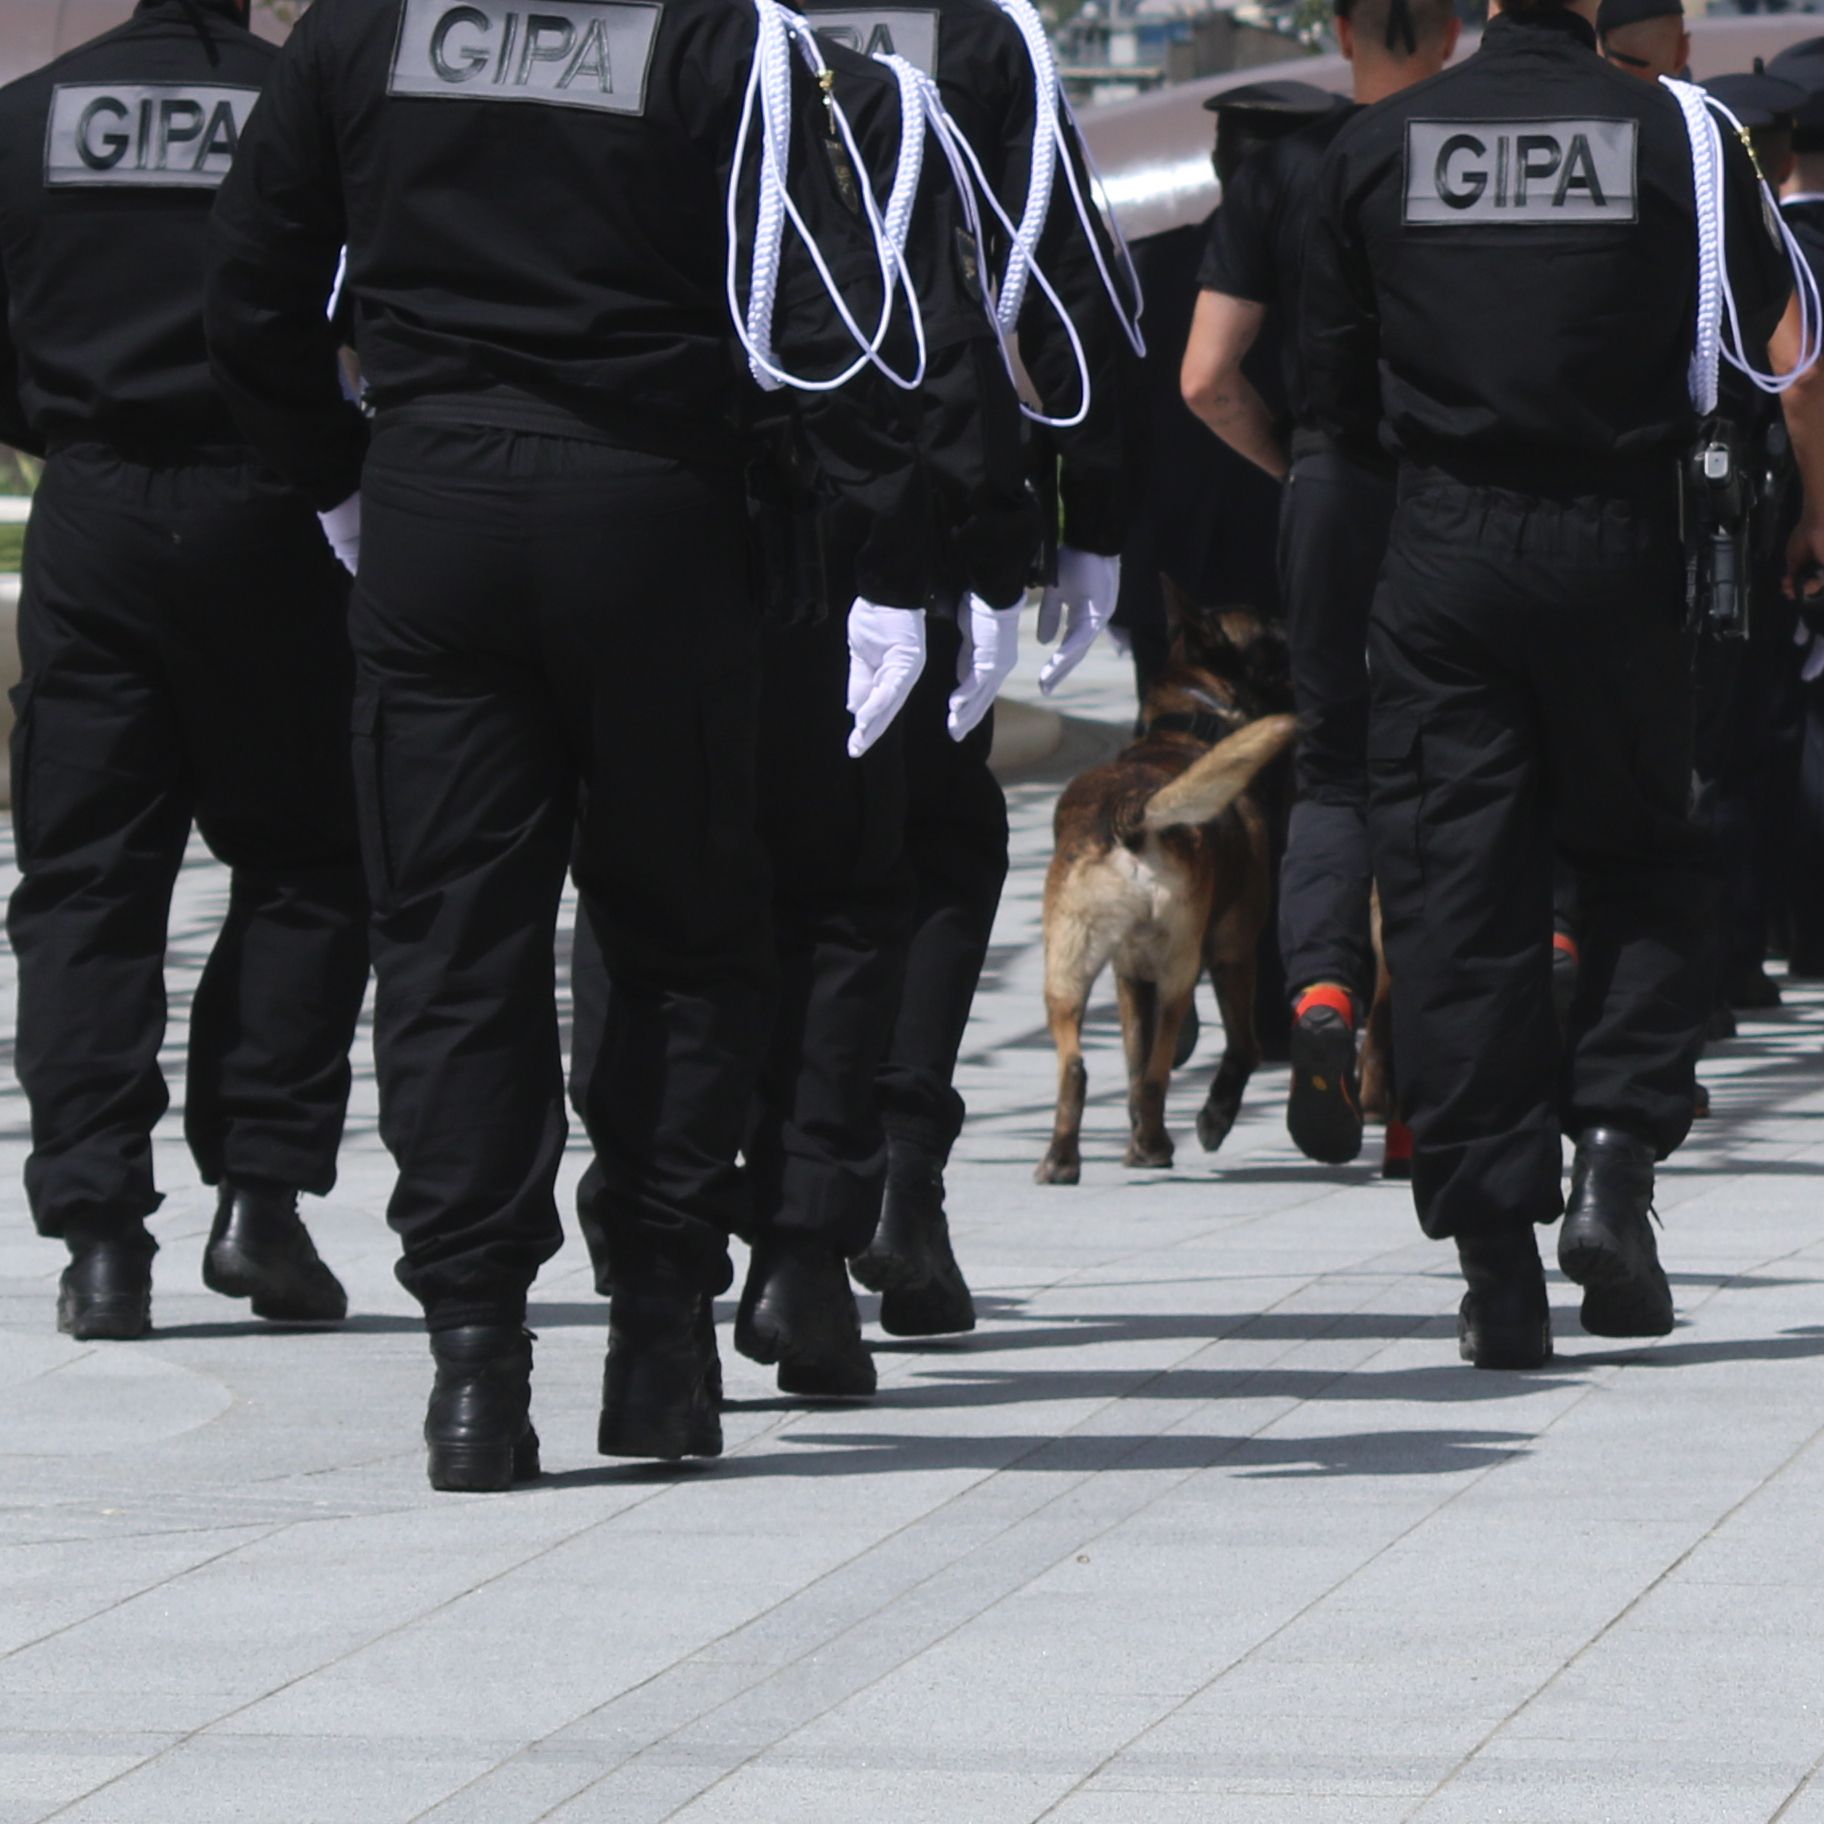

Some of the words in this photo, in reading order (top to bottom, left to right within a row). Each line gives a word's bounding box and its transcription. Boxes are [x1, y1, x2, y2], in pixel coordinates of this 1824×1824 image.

[429, 4, 614, 95] GIPA
[75, 95, 241, 171] GIPA
[1433, 133, 1609, 210] GIPA
